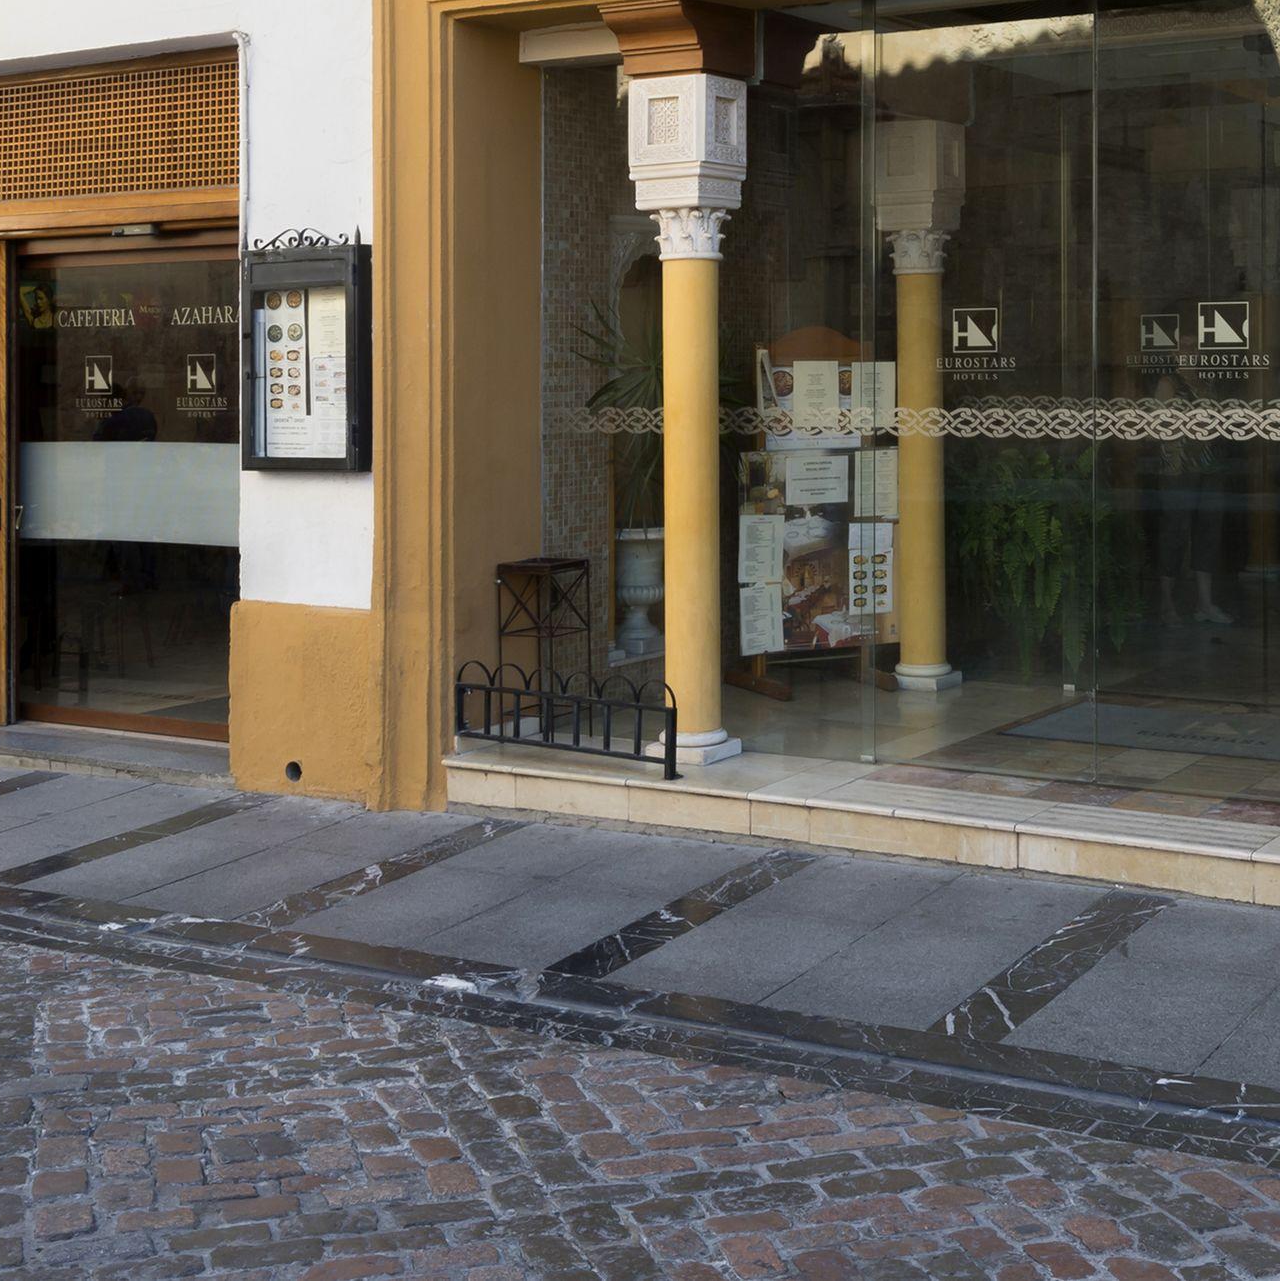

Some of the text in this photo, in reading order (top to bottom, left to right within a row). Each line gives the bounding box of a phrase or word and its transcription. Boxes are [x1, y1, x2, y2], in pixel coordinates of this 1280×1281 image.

[58, 307, 136, 328] CAFETERIA
[936, 356, 1016, 369] EUROSTARS
[1179, 354, 1270, 367] EUROSTARS
[953, 372, 998, 381] HOTELS
[1198, 371, 1249, 379] HOTELS
[177, 397, 228, 408] EUROSTARS
